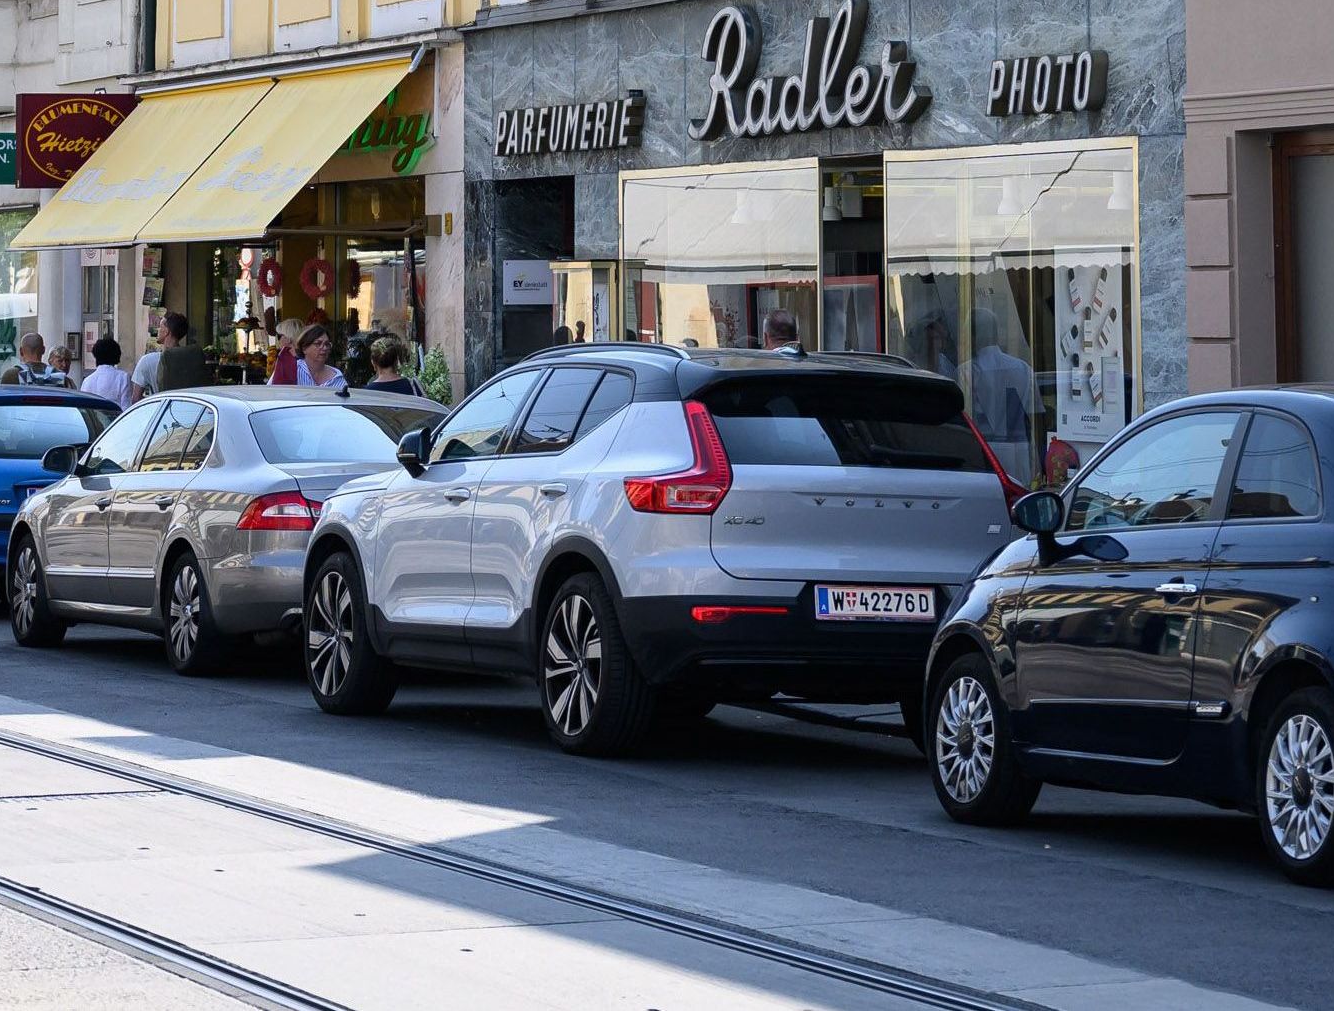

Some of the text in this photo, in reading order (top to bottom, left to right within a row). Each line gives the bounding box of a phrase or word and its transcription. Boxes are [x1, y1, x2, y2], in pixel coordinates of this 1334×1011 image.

[494, 98, 634, 156] PARFUMERIE
[986, 50, 1108, 115] PHOTO
[513, 280, 523, 288] EY
[813, 497, 941, 509] VOLVO
[832, 591, 845, 611] W
